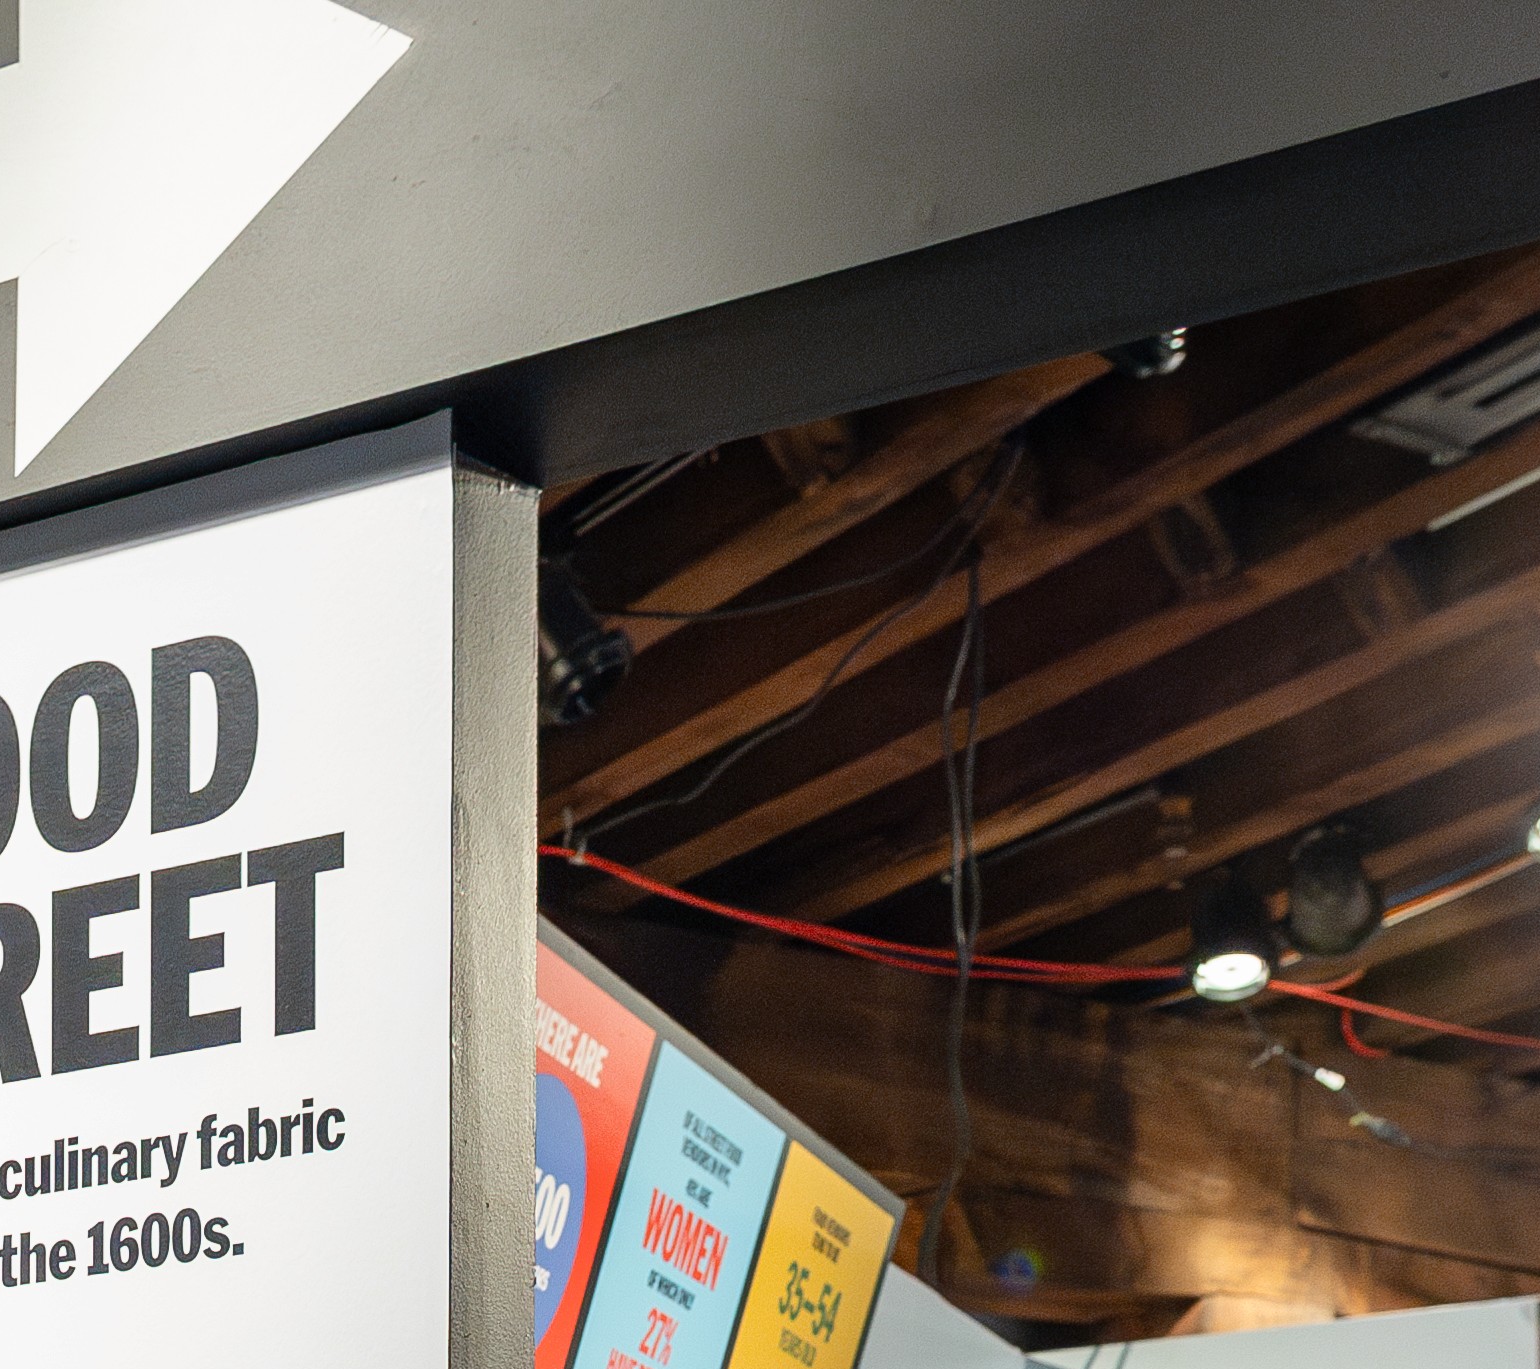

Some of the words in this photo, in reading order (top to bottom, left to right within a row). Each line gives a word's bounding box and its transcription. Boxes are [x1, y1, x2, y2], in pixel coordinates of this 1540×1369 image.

[196, 1097, 346, 1171] fabric
[87, 1207, 245, 1276] 1600s.
[642, 1186, 729, 1291] WOMEN
[638, 1307, 679, 1366] 27%
